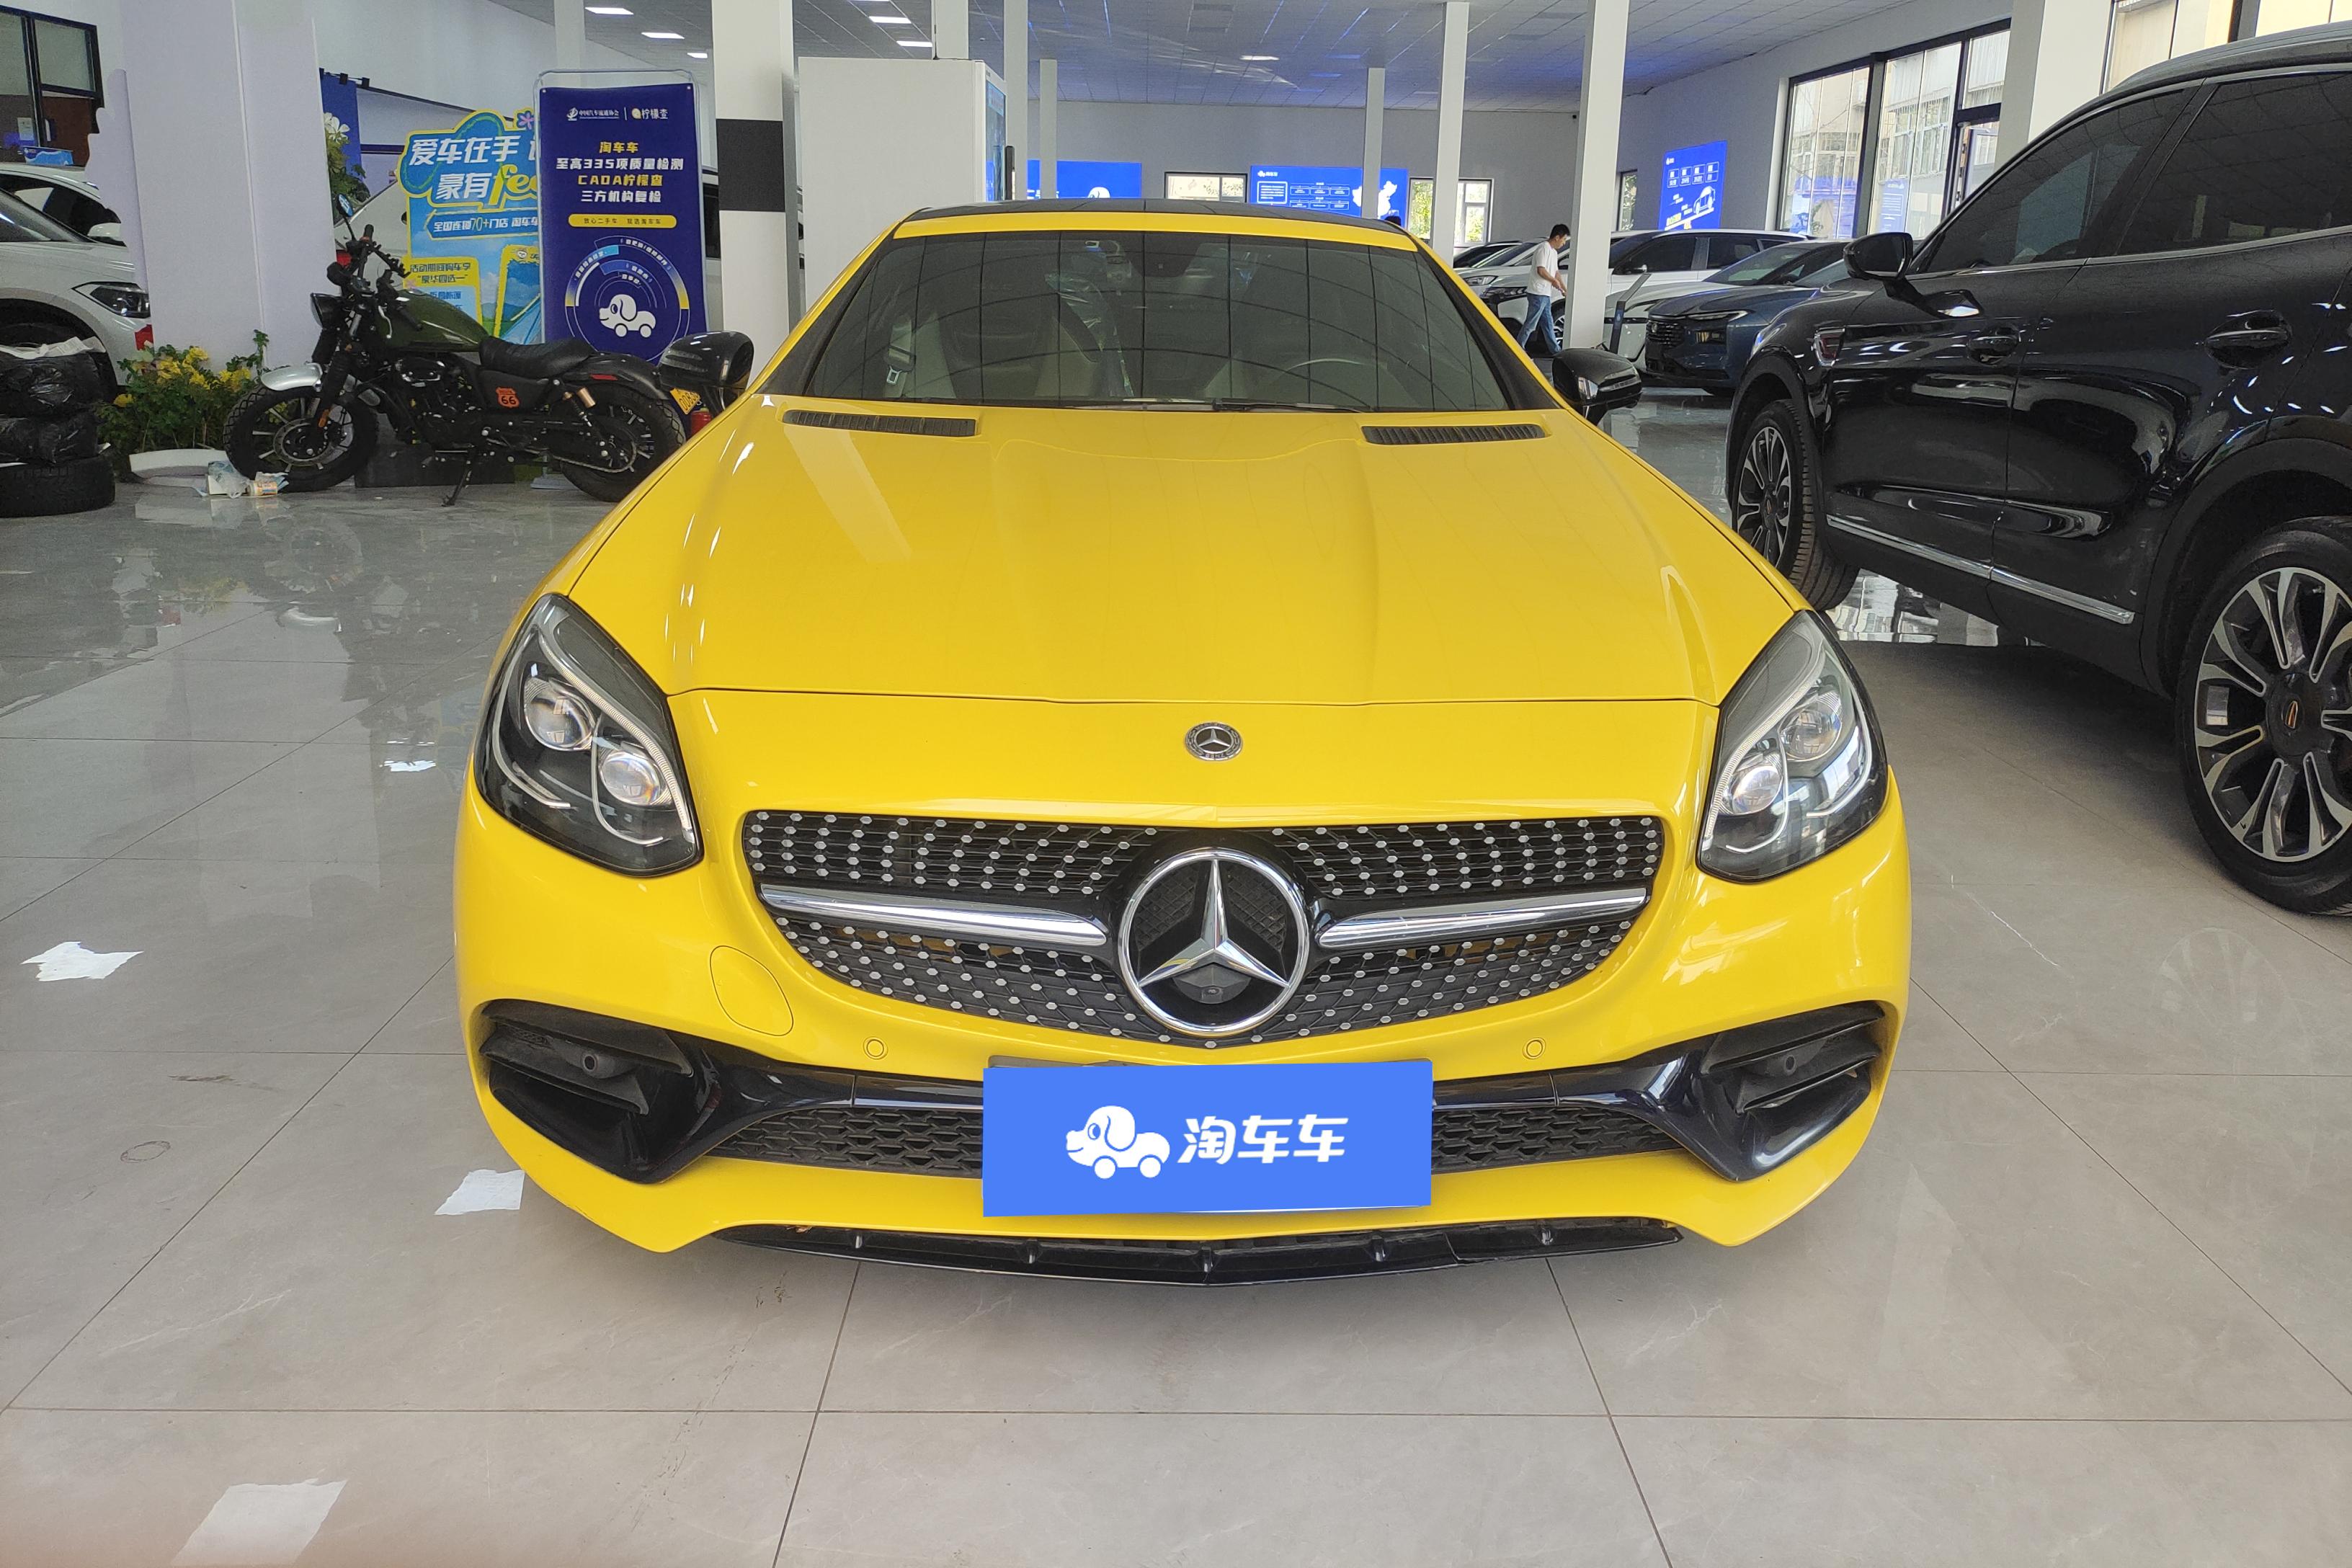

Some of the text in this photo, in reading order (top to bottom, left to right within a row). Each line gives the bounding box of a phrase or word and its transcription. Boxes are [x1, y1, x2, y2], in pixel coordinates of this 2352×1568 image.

[641, 108, 669, 120] 柠檬查
[409, 135, 522, 166] 爱车在手
[599, 141, 639, 153] 淘车车
[556, 157, 684, 171] 至高335项质量检测
[578, 174, 663, 187] CADA柠檬查
[581, 190, 662, 202] 三方机构复检
[501, 396, 517, 405] 66
